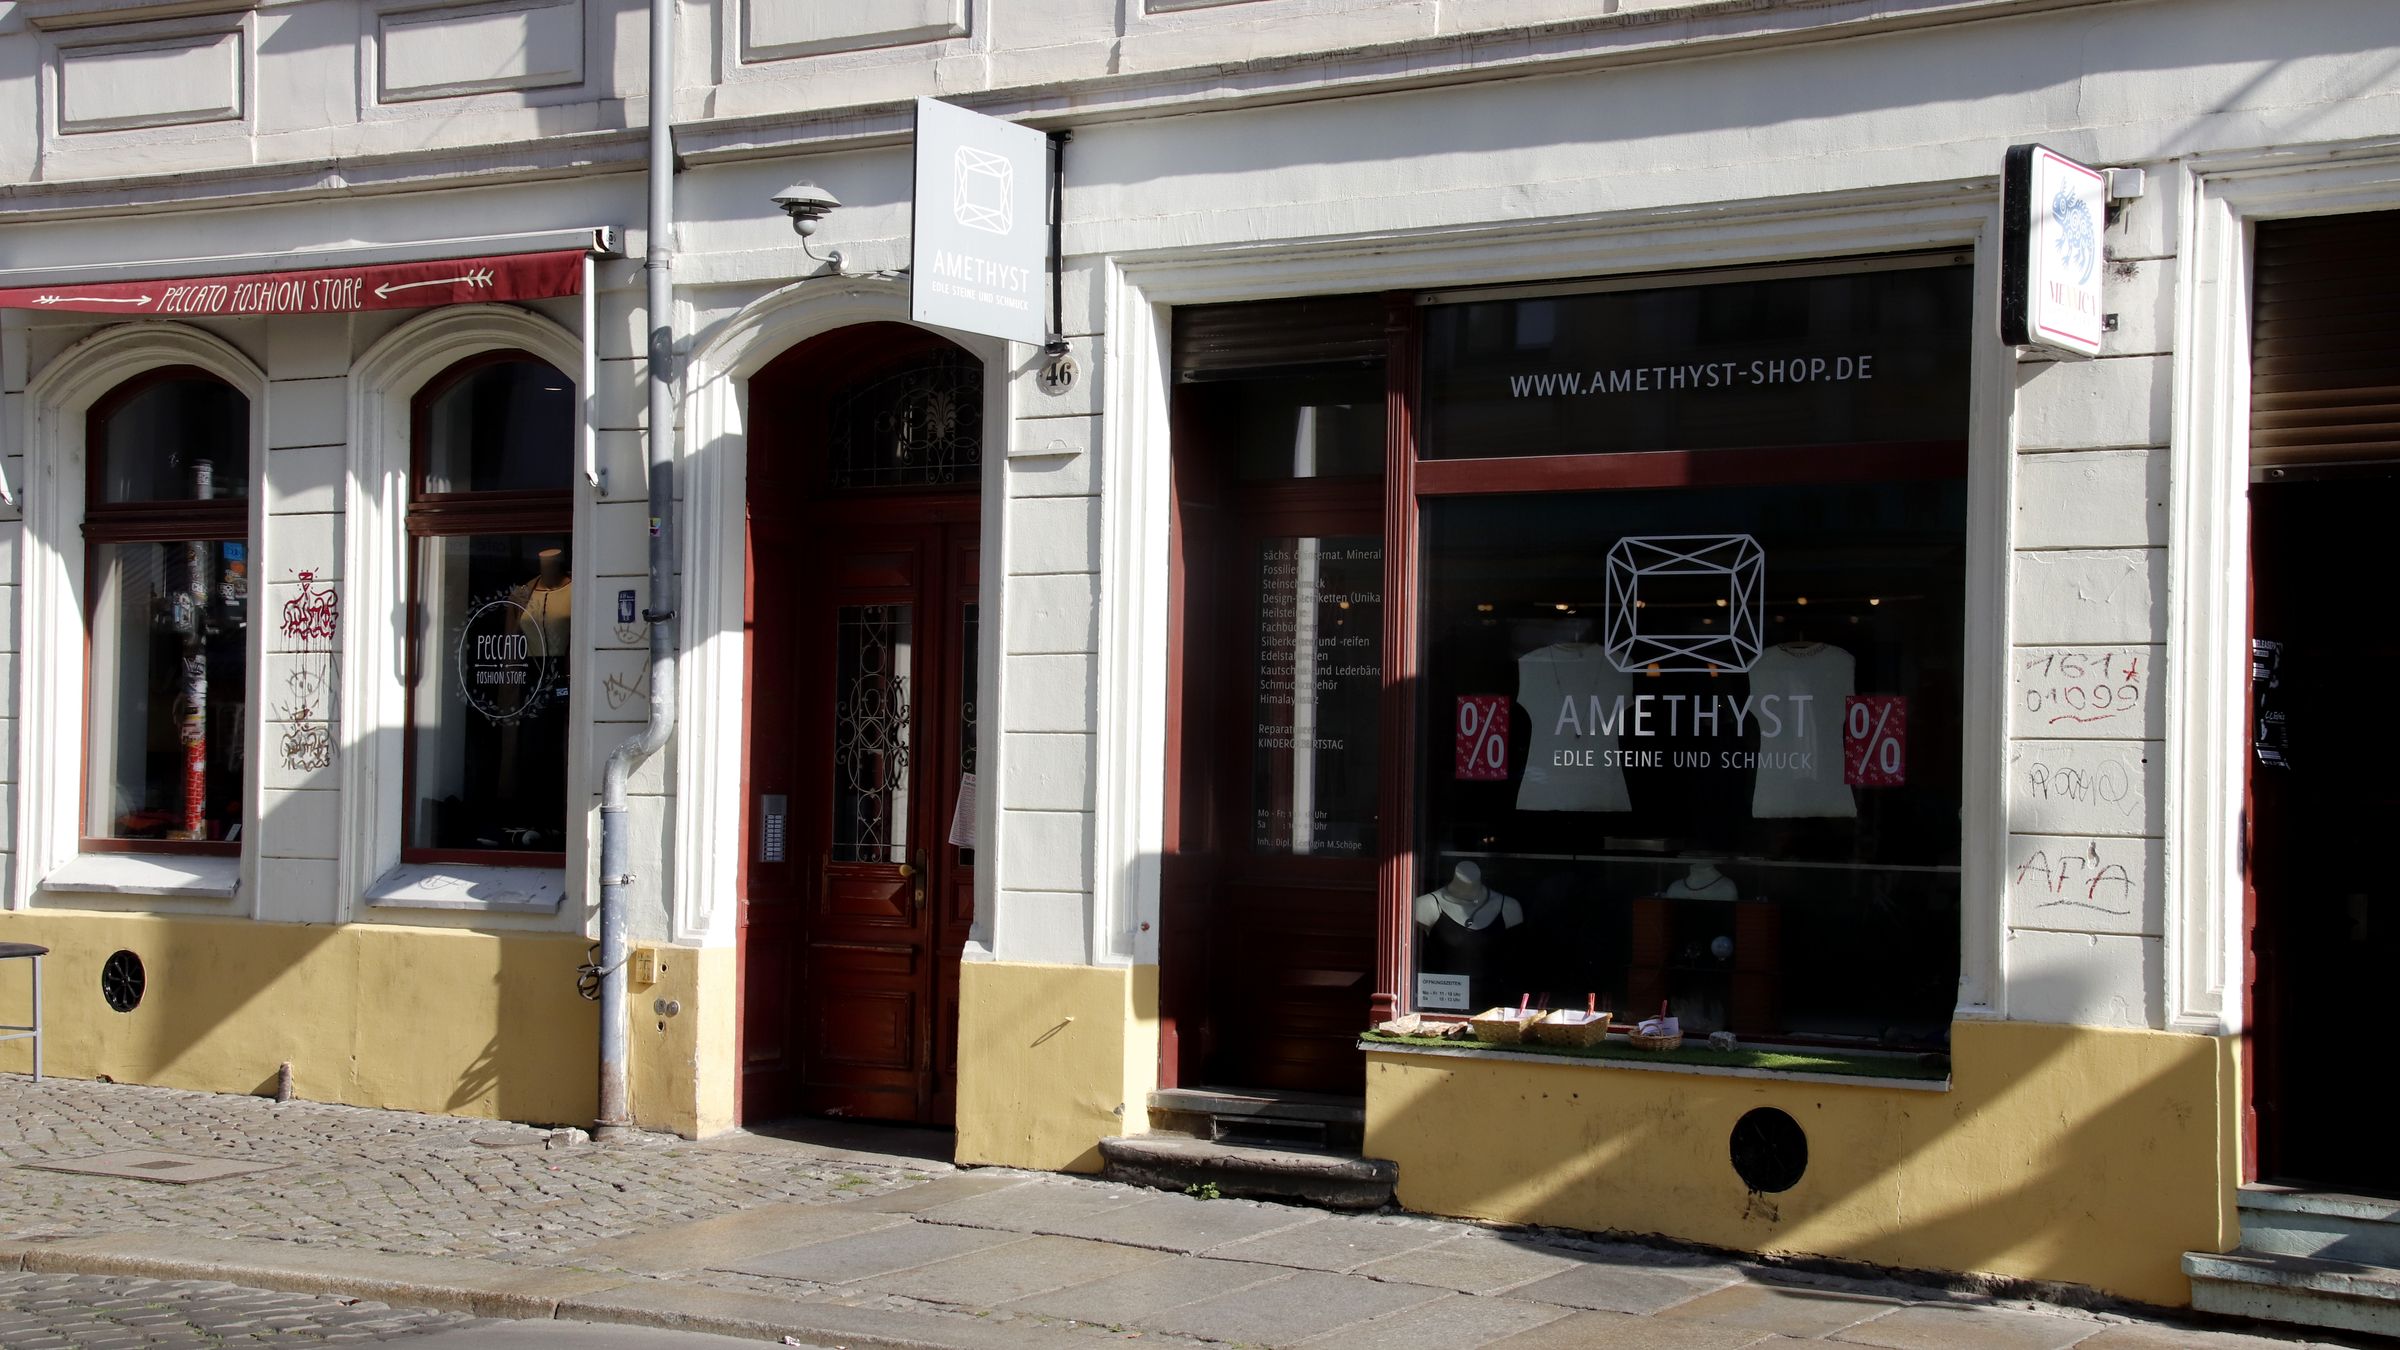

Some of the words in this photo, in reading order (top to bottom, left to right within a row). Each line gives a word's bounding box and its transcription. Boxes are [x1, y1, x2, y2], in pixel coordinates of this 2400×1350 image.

[933, 248, 1030, 293] AMETHYST
[932, 280, 950, 295] EDLE
[951, 285, 976, 300] STEINE
[978, 291, 994, 304] UND
[996, 295, 1029, 311] SCHMUCK
[1045, 362, 1072, 386] 46
[1511, 355, 1873, 398] WWW.AMETHYST-SHOP.DE
[1318, 636, 1337, 647] und
[1339, 635, 1371, 647] -reifen
[2026, 684, 2139, 712] 01099
[1554, 694, 1814, 738] AMETHYST
[1553, 750, 1594, 767] EDLE
[1603, 750, 1664, 768] STEINE
[1673, 751, 1711, 768] UND
[1721, 751, 1813, 769] SCHMUCK
